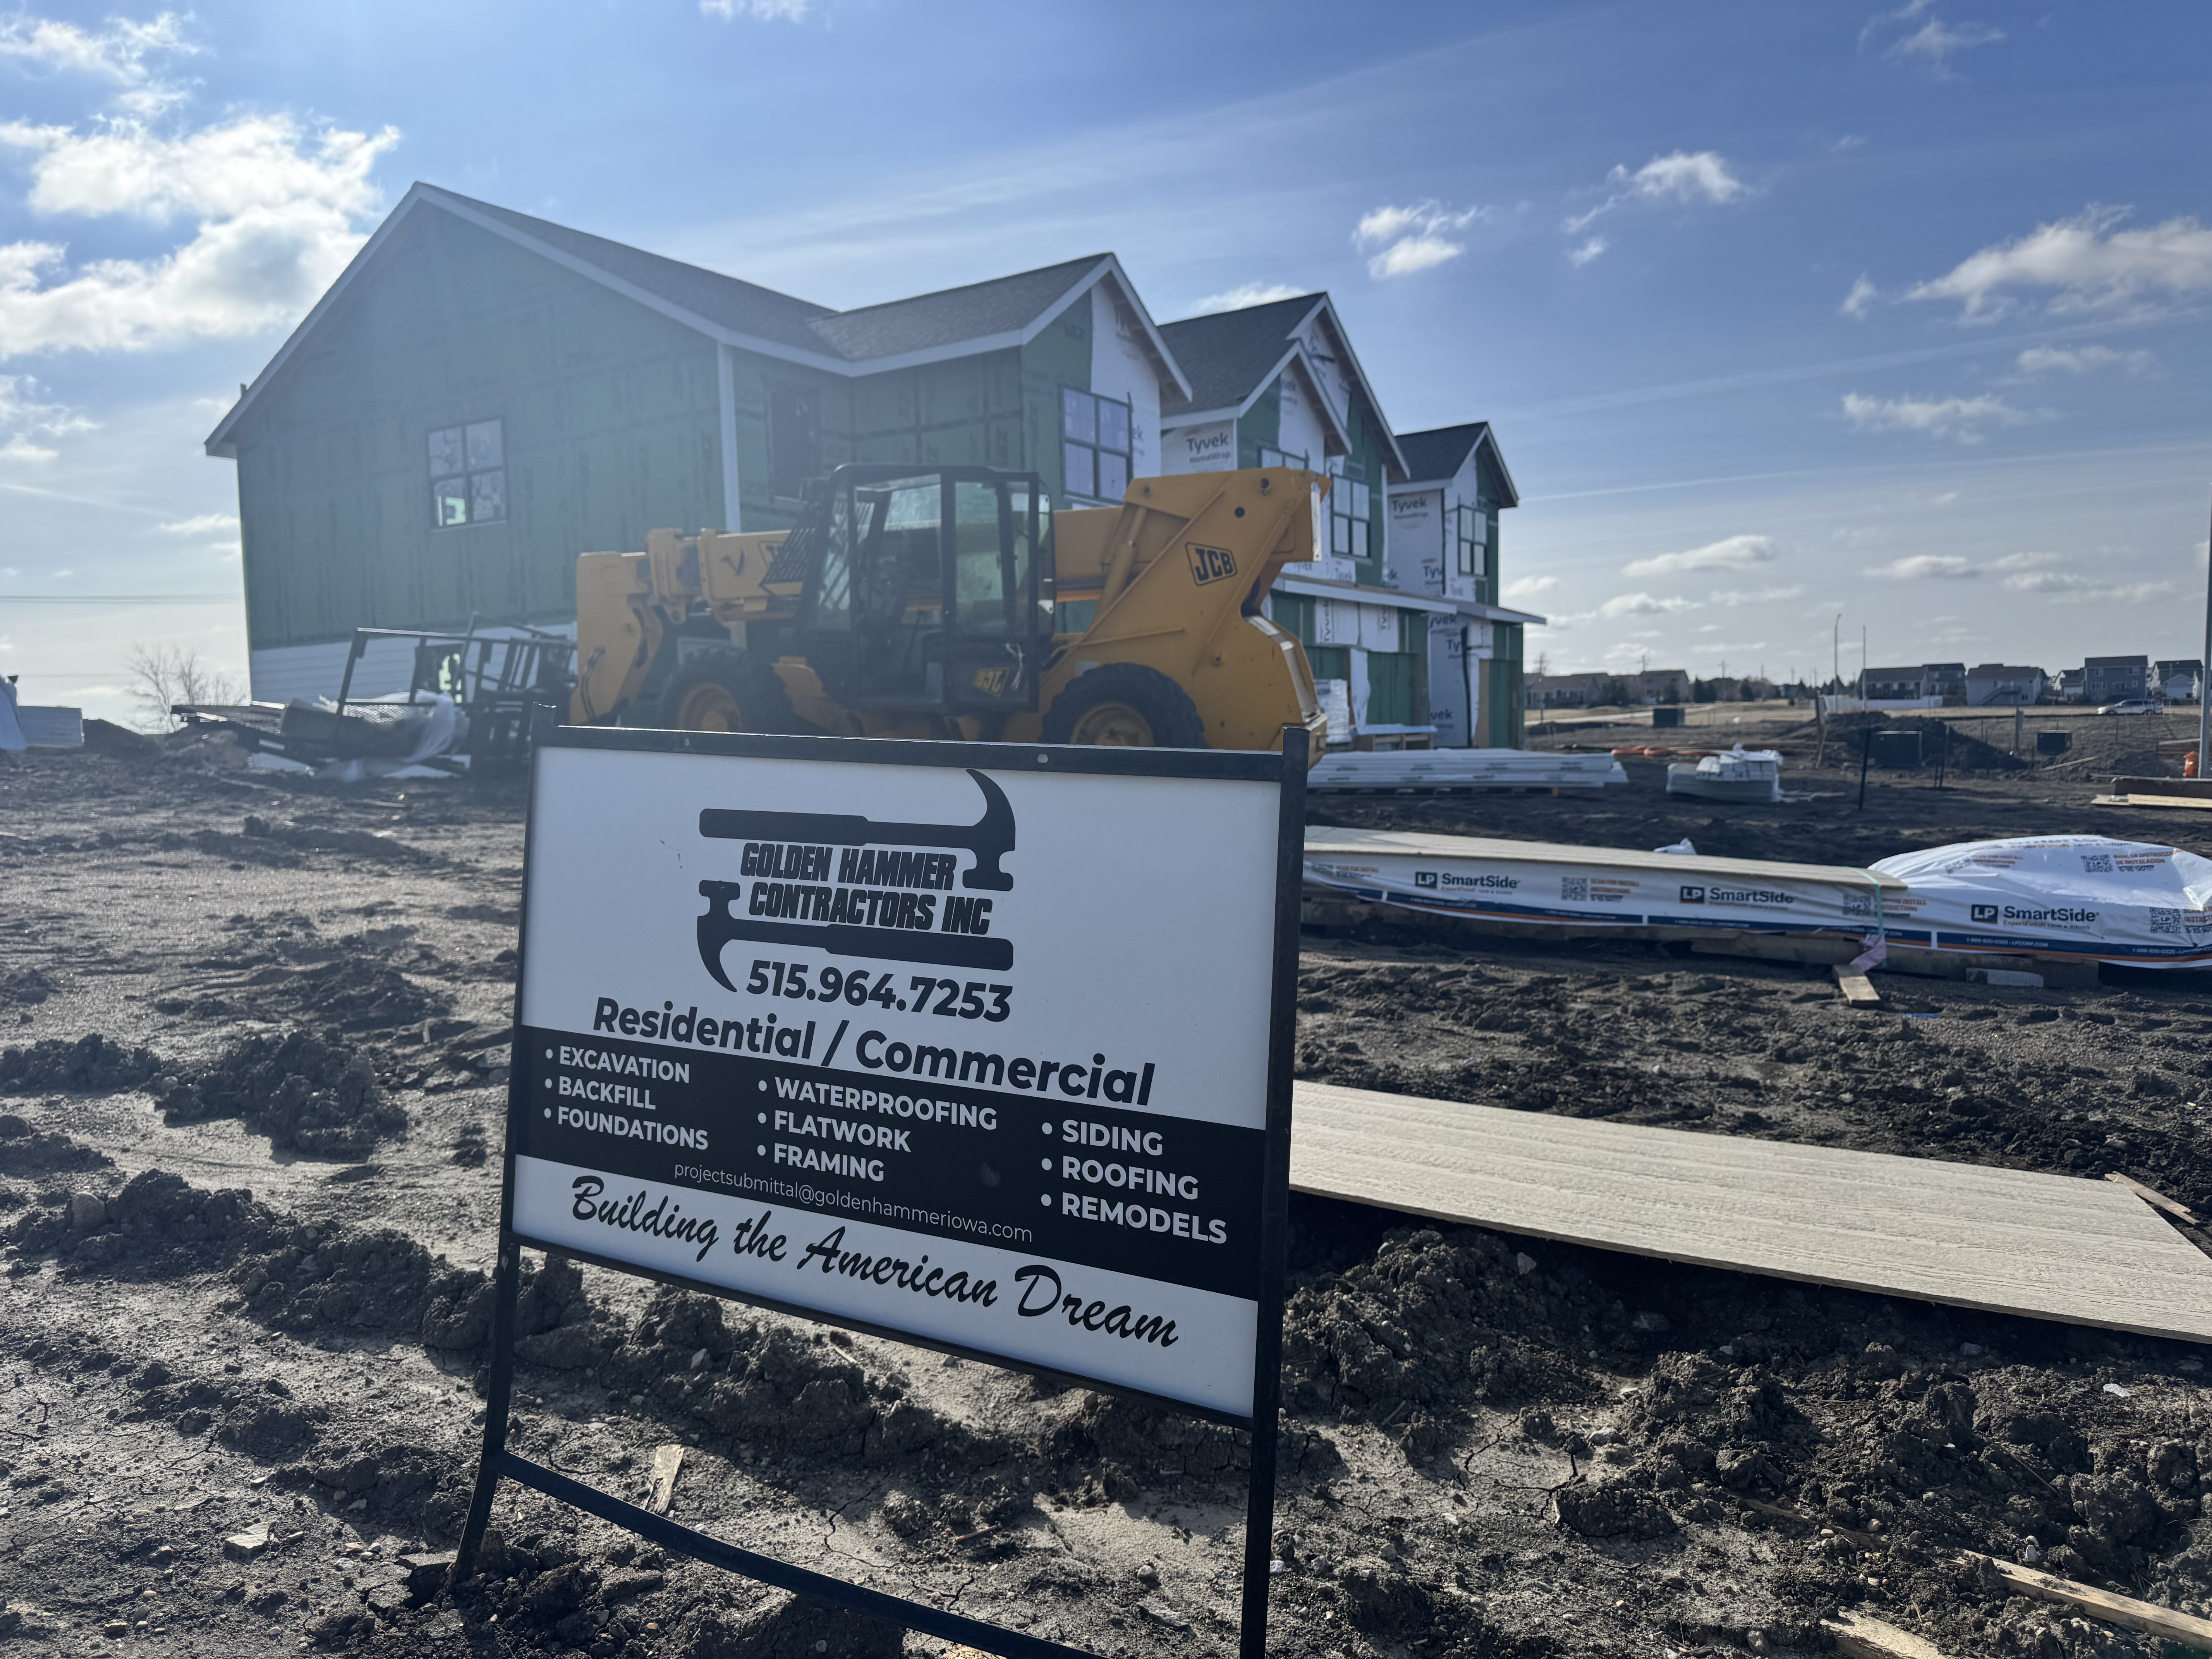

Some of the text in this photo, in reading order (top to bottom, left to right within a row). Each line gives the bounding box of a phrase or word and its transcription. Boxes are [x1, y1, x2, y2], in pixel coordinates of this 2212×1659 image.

[1187, 432, 1229, 454] Tyvek
[1392, 498, 1427, 513] Tyvek
[1195, 548, 1233, 581] JCB
[740, 843, 957, 891] GOLDEN HAMMER
[1417, 873, 1519, 889] LP SmartSide
[749, 882, 993, 935] CONTRACTORS INC
[1683, 887, 1794, 903] LP SmartSide
[1973, 906, 2096, 922] LP SmartSide
[746, 960, 1013, 1022] 515.964.7253
[560, 1046, 689, 1084] EXCAVATION
[593, 997, 1156, 1106] Residential / Commercial
[559, 1076, 656, 1110] BACKFILL
[775, 1077, 997, 1130] WATERPROOFING
[558, 1106, 708, 1150] FOUNDATIONS
[775, 1109, 911, 1152] FLATWORK
[1062, 1119, 1163, 1156] SIDING
[774, 1143, 884, 1182] FRAMING
[1063, 1155, 1199, 1200] ROOFING
[675, 1163, 1032, 1243] projectsubmittal@goldenhammeriowa.com
[1062, 1192, 1227, 1244] REMODELS
[572, 1175, 1179, 1347] Building the American Dream
